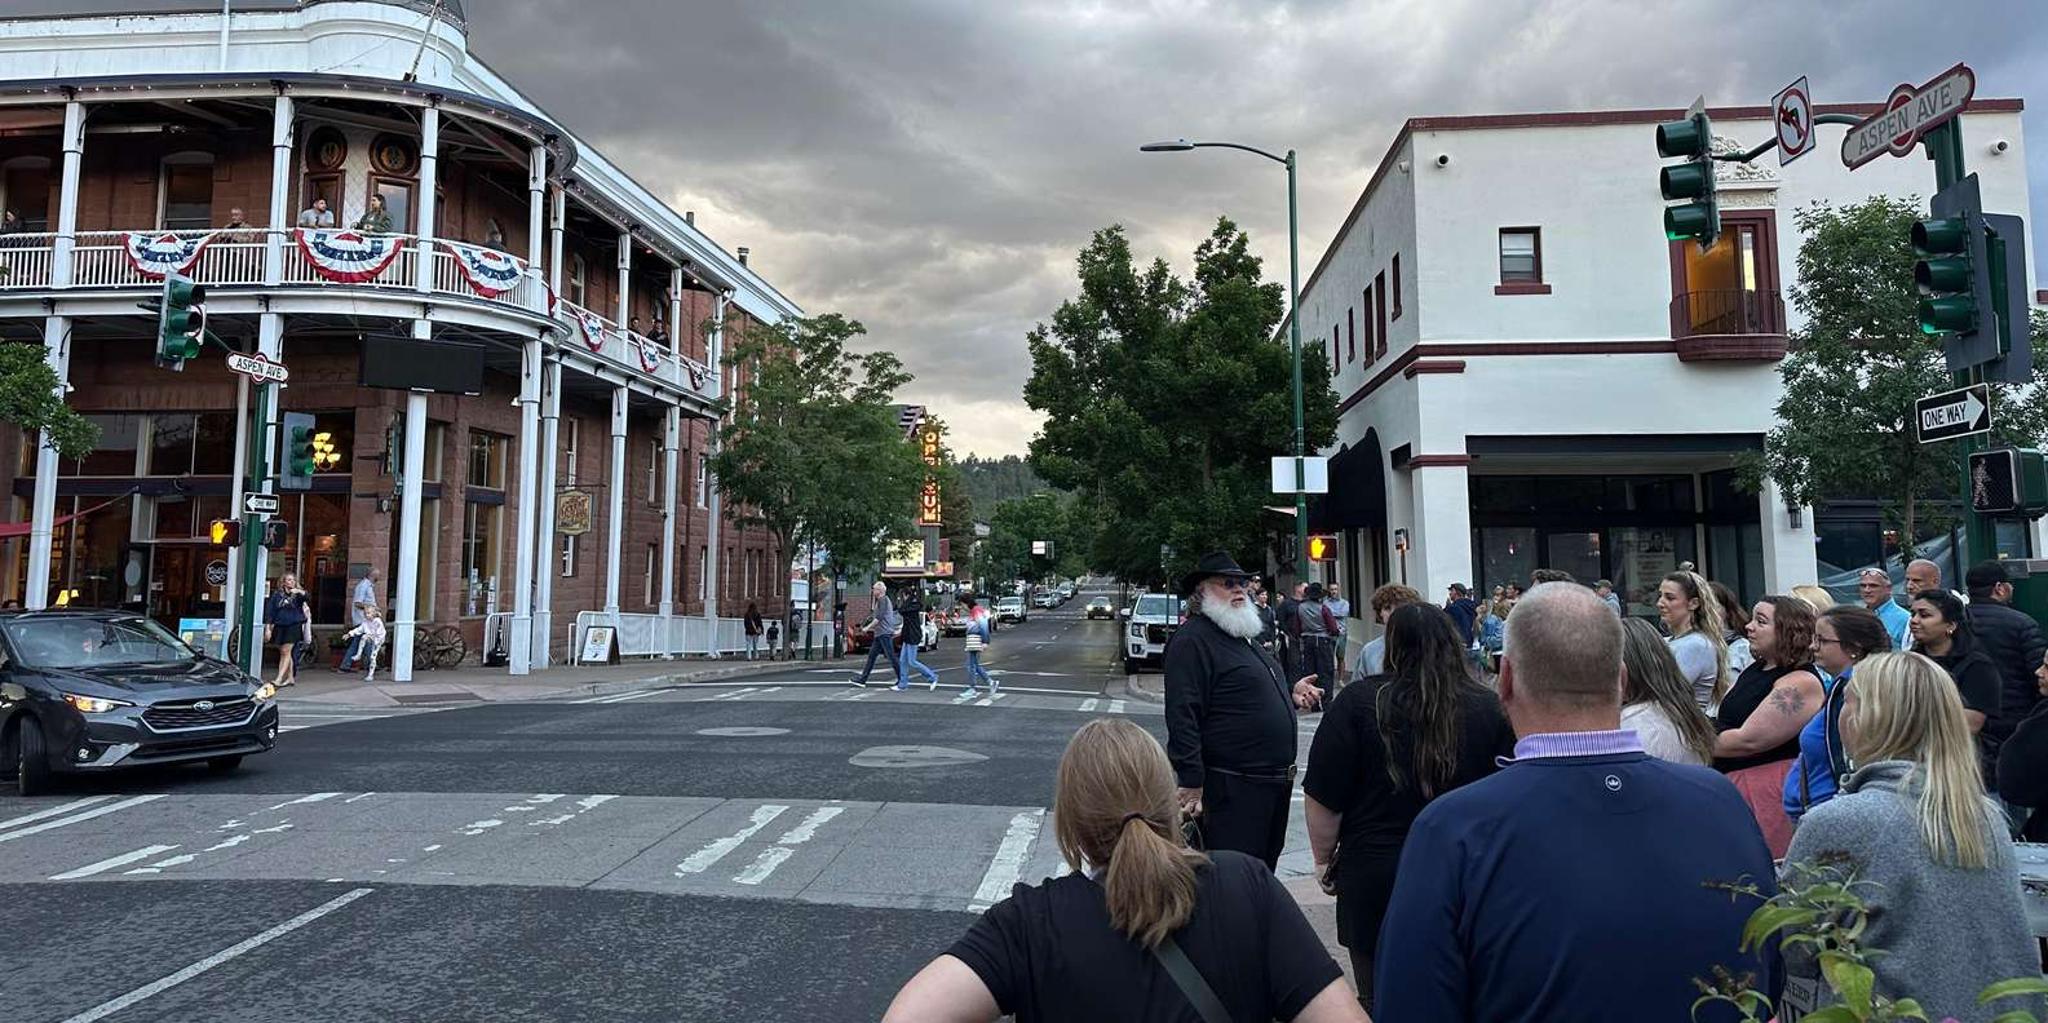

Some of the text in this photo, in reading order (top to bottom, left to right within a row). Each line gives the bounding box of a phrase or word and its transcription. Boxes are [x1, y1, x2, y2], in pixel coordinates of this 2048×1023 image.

[1859, 82, 1952, 155] ASPEN AVE
[236, 358, 283, 379] ASPEN AVE
[1924, 402, 1967, 428] ONE WAY
[924, 432, 937, 521] ORPUM
